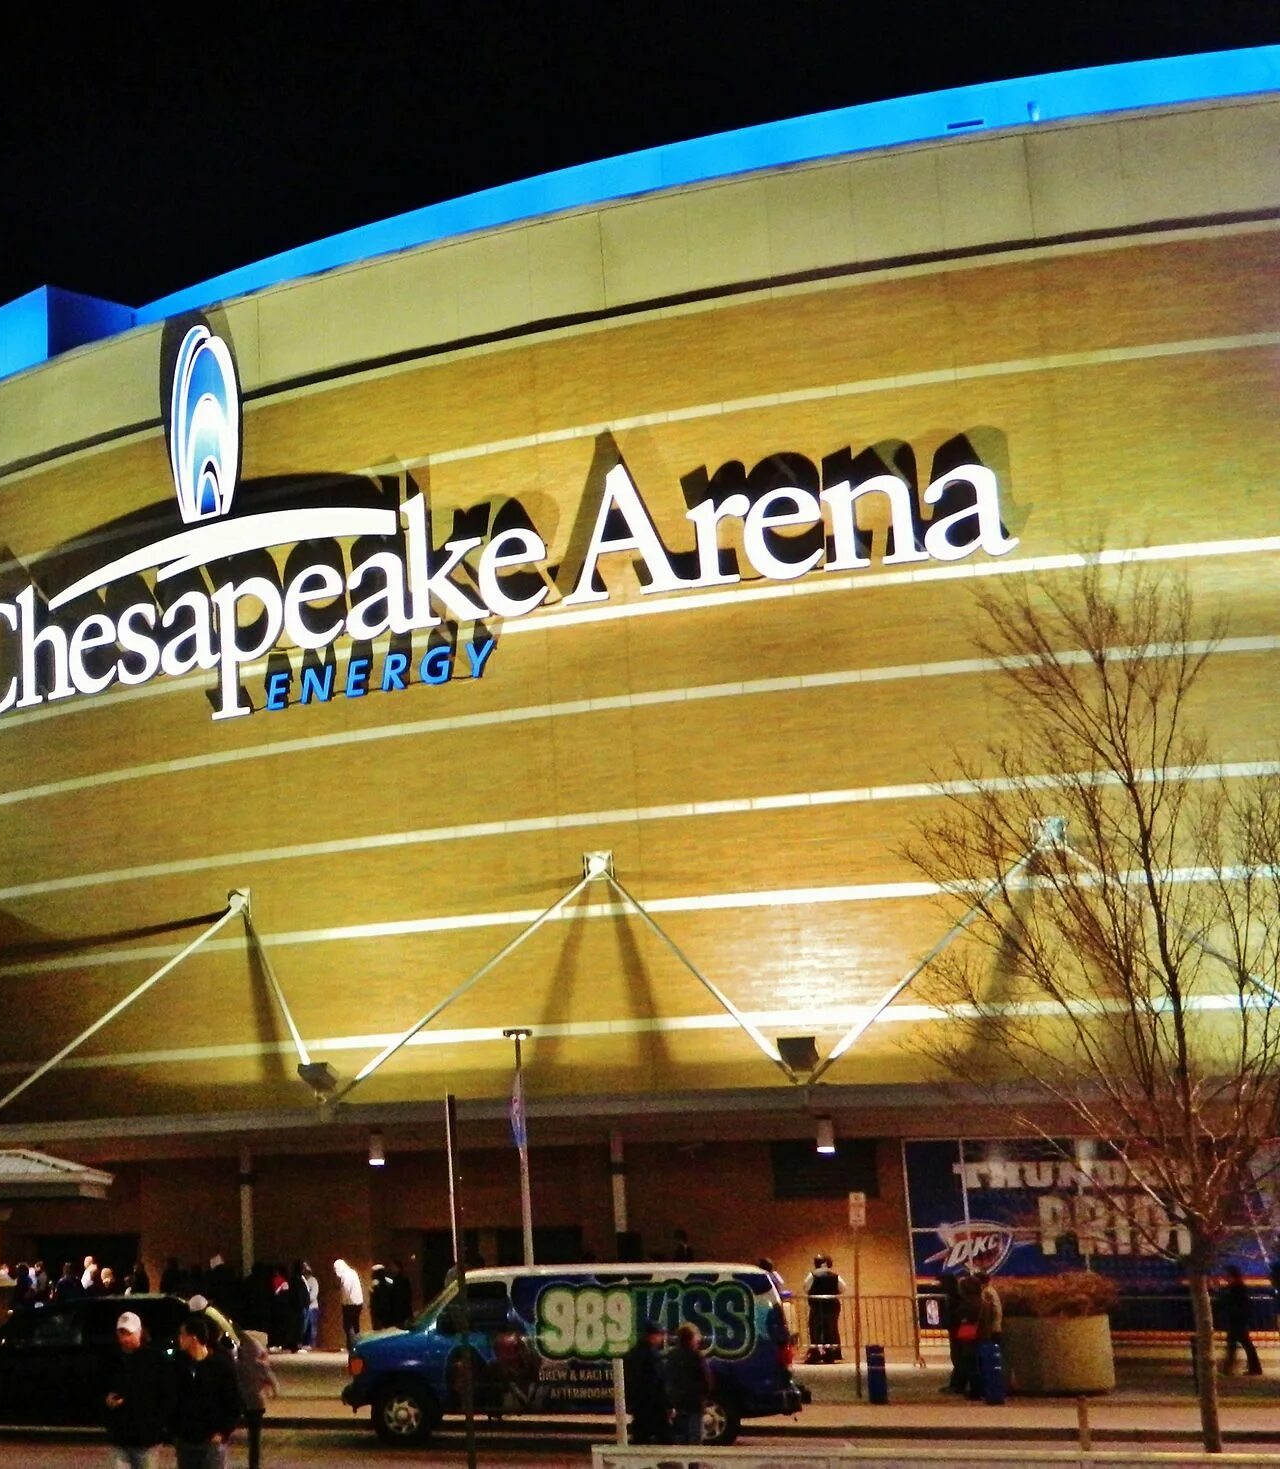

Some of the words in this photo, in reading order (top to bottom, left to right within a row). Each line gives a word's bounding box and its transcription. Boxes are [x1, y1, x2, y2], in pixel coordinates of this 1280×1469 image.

[564, 463, 1019, 606] Arena
[266, 640, 496, 711] ENERGY
[947, 1234, 998, 1268] OKC
[543, 1290, 632, 1353] 989
